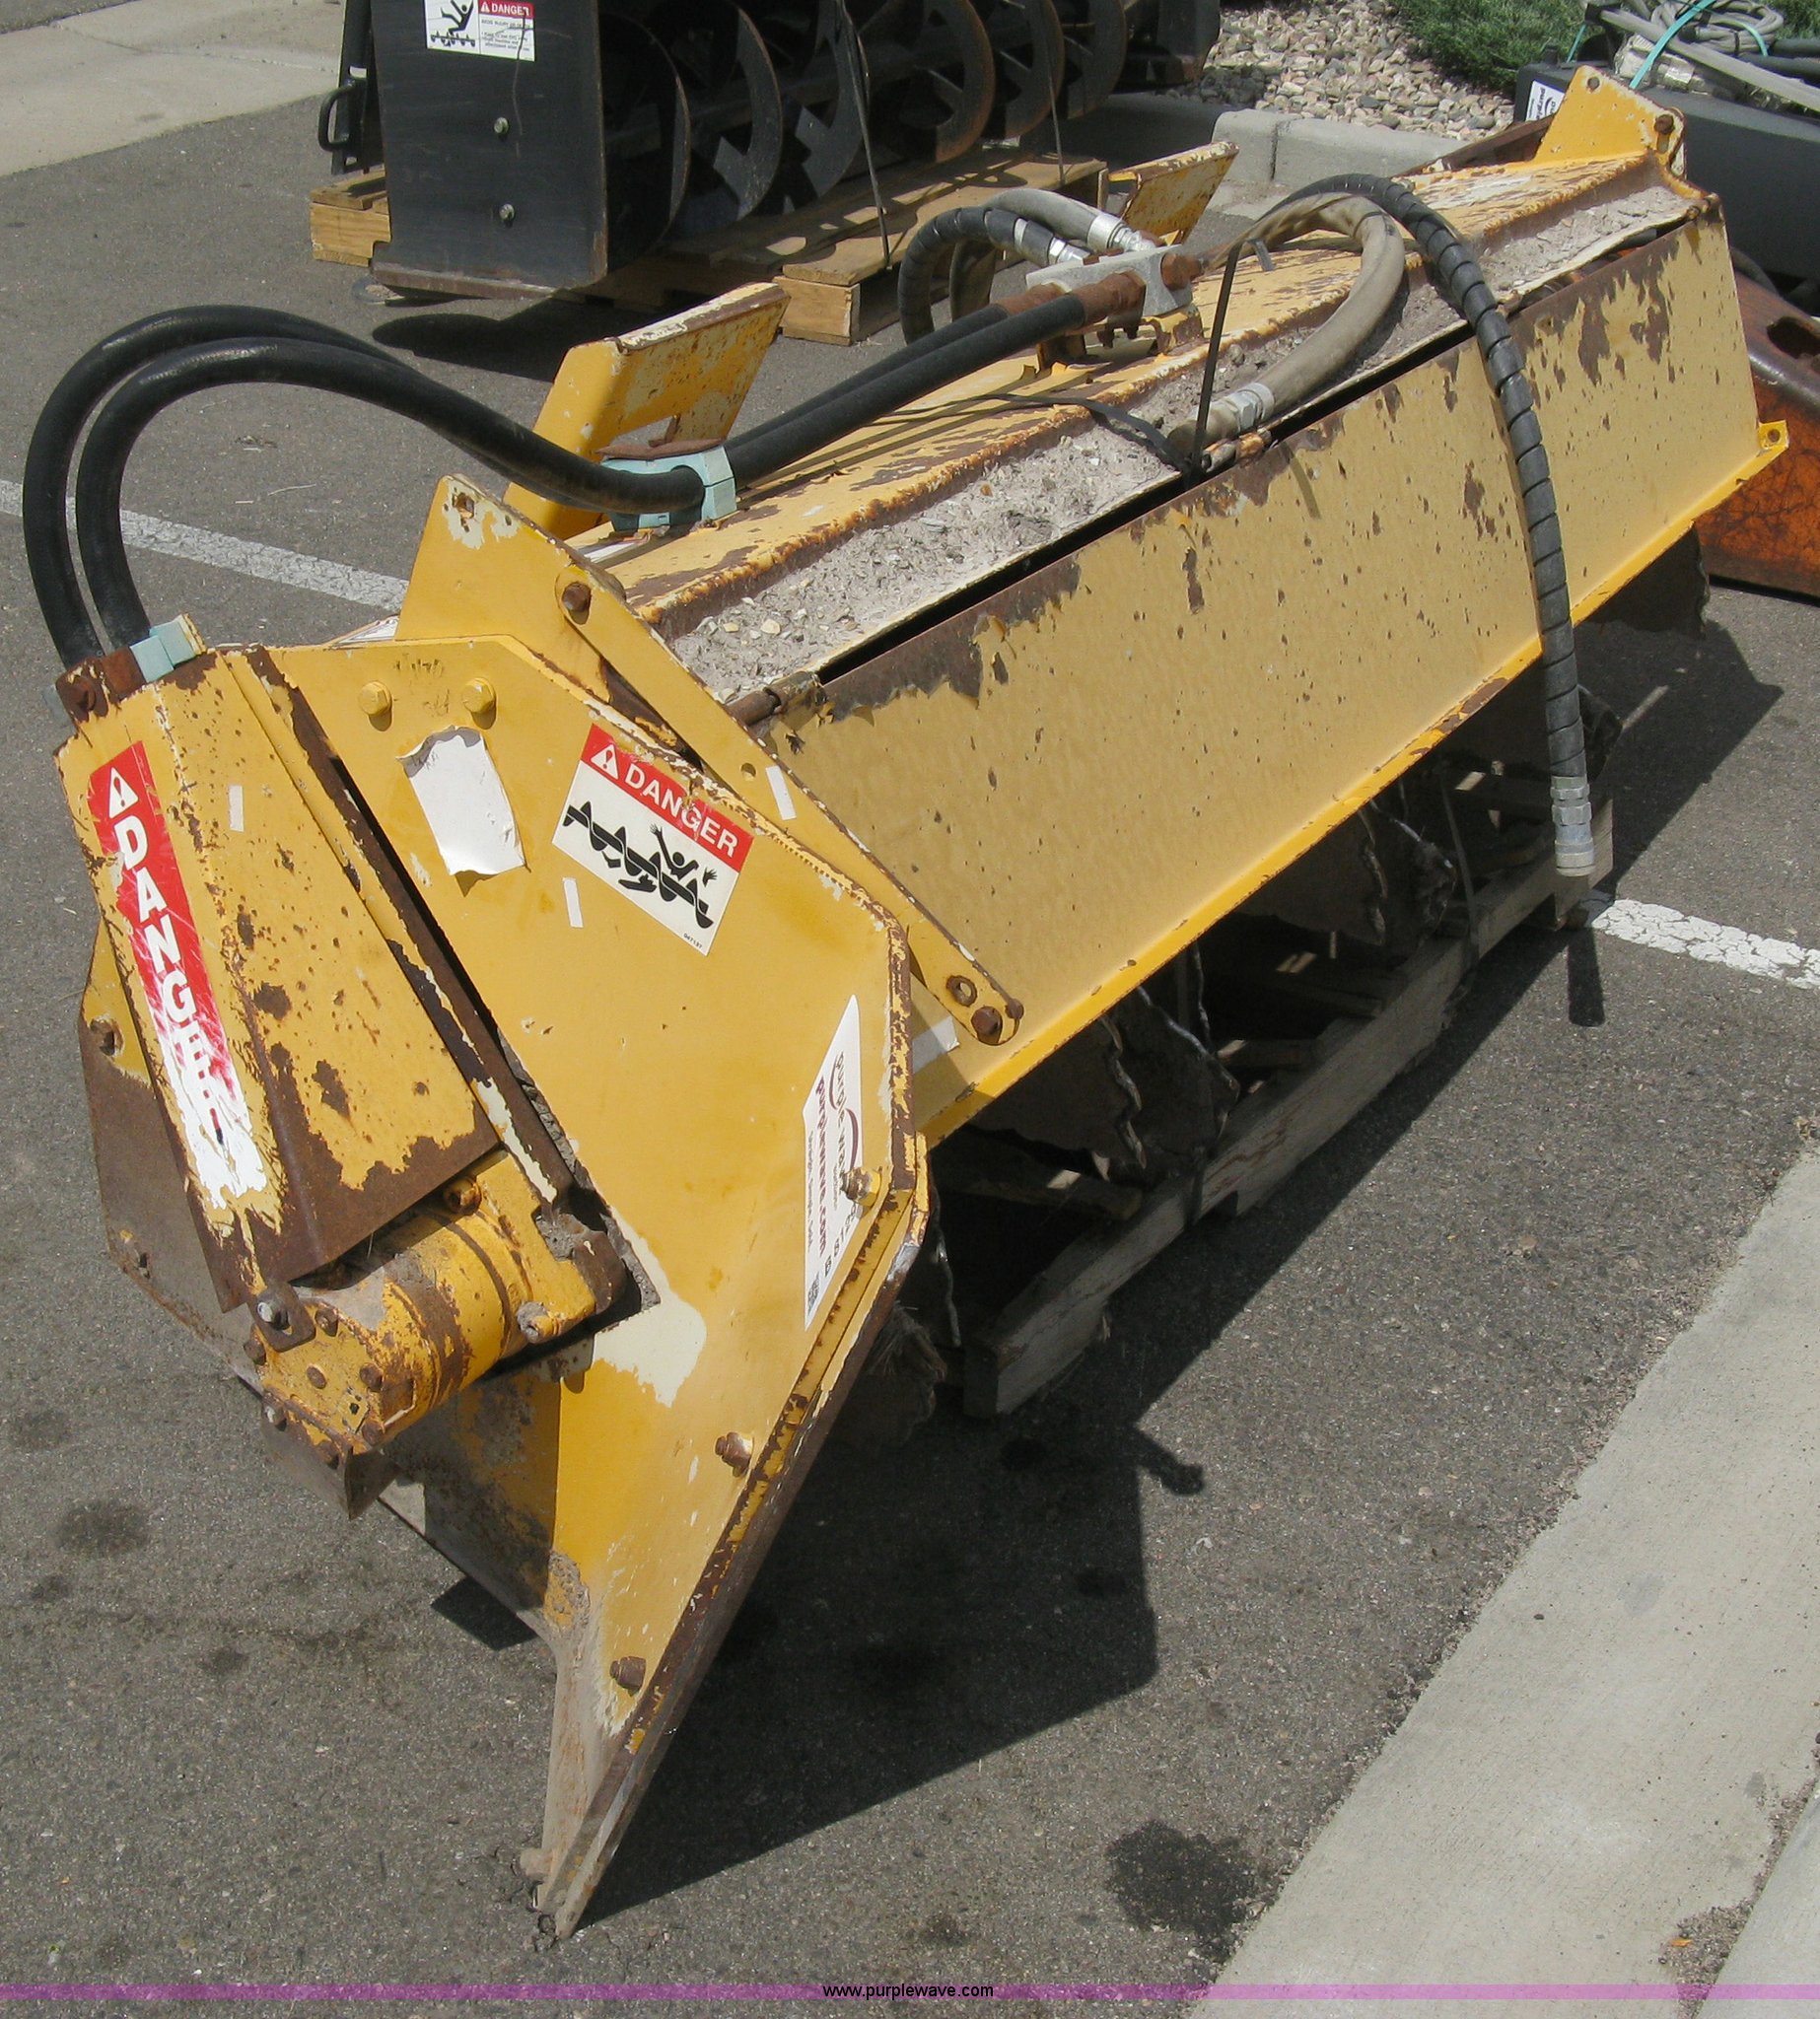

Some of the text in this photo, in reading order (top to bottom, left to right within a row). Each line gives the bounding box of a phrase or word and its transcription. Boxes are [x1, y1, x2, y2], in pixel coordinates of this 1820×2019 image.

[624, 763, 738, 858] DANGER
[113, 814, 221, 1104] DANGE
[835, 1051, 847, 1128] purple
[815, 1076, 828, 1258] purplewave.com
